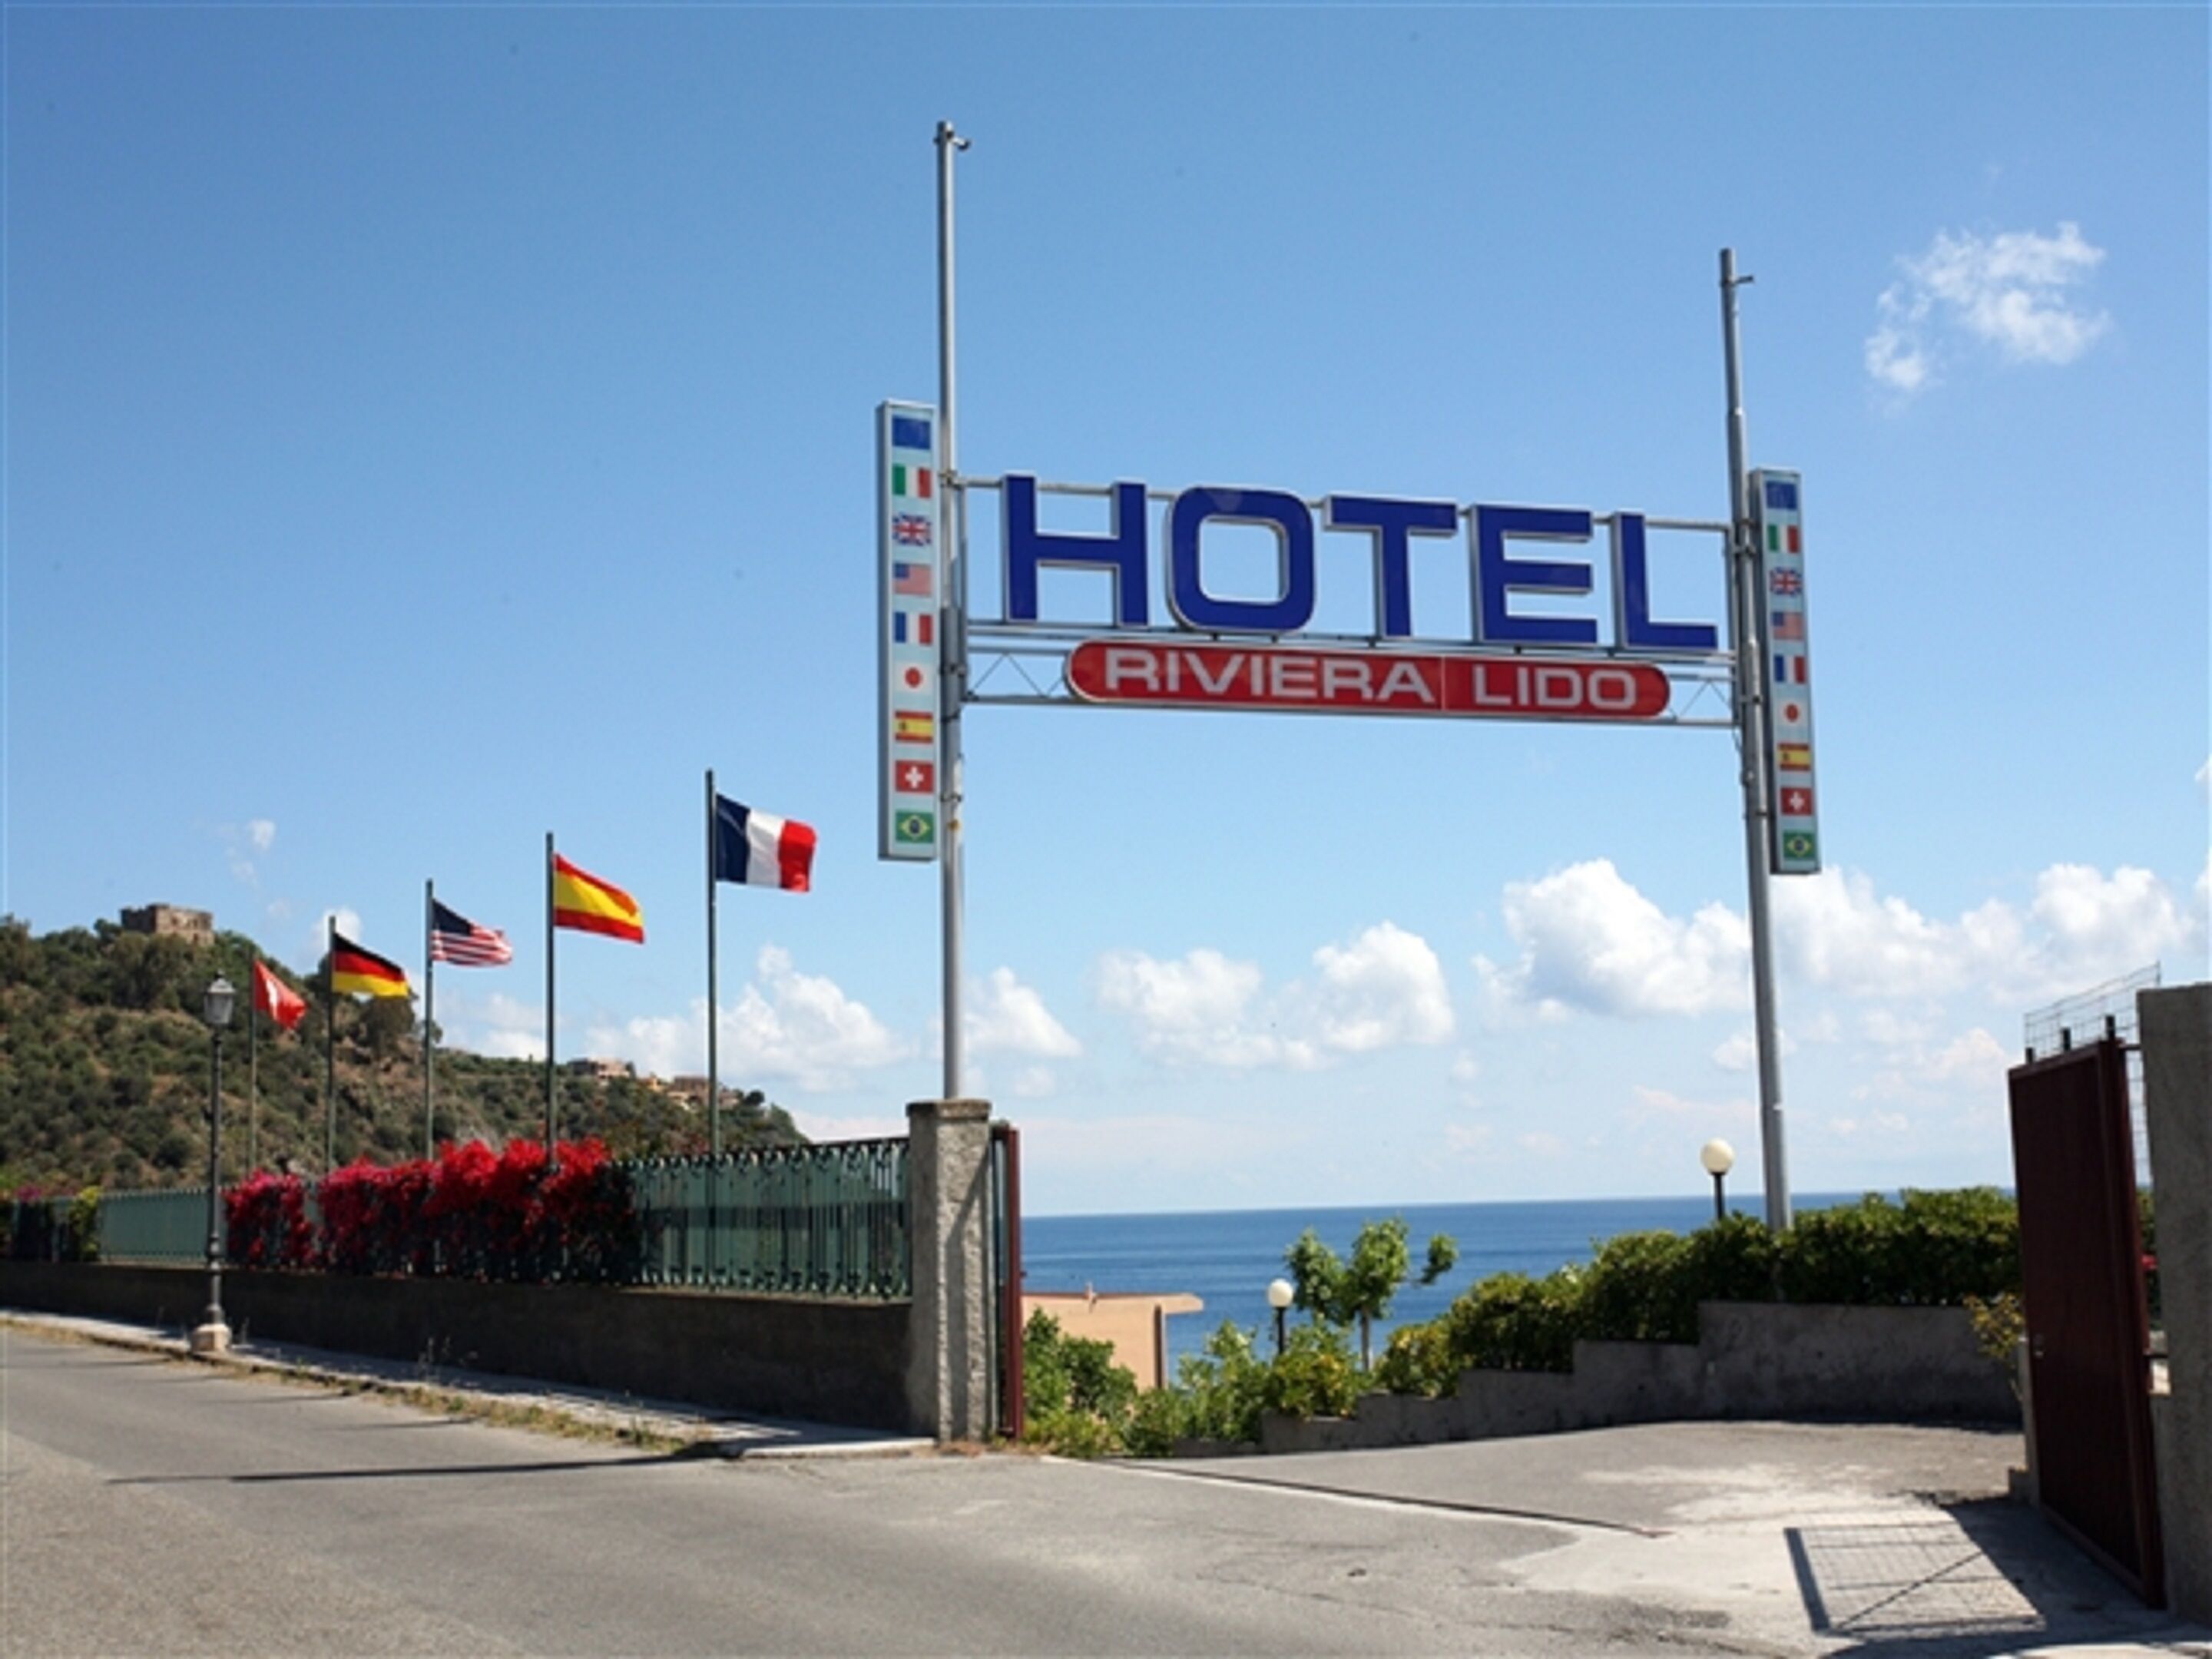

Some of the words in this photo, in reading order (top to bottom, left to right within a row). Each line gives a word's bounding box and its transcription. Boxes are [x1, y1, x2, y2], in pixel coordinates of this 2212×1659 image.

[1002, 474, 1718, 651] HOTEL
[1104, 647, 1435, 704] RIVIERA
[1472, 666, 1638, 710] LIDO
